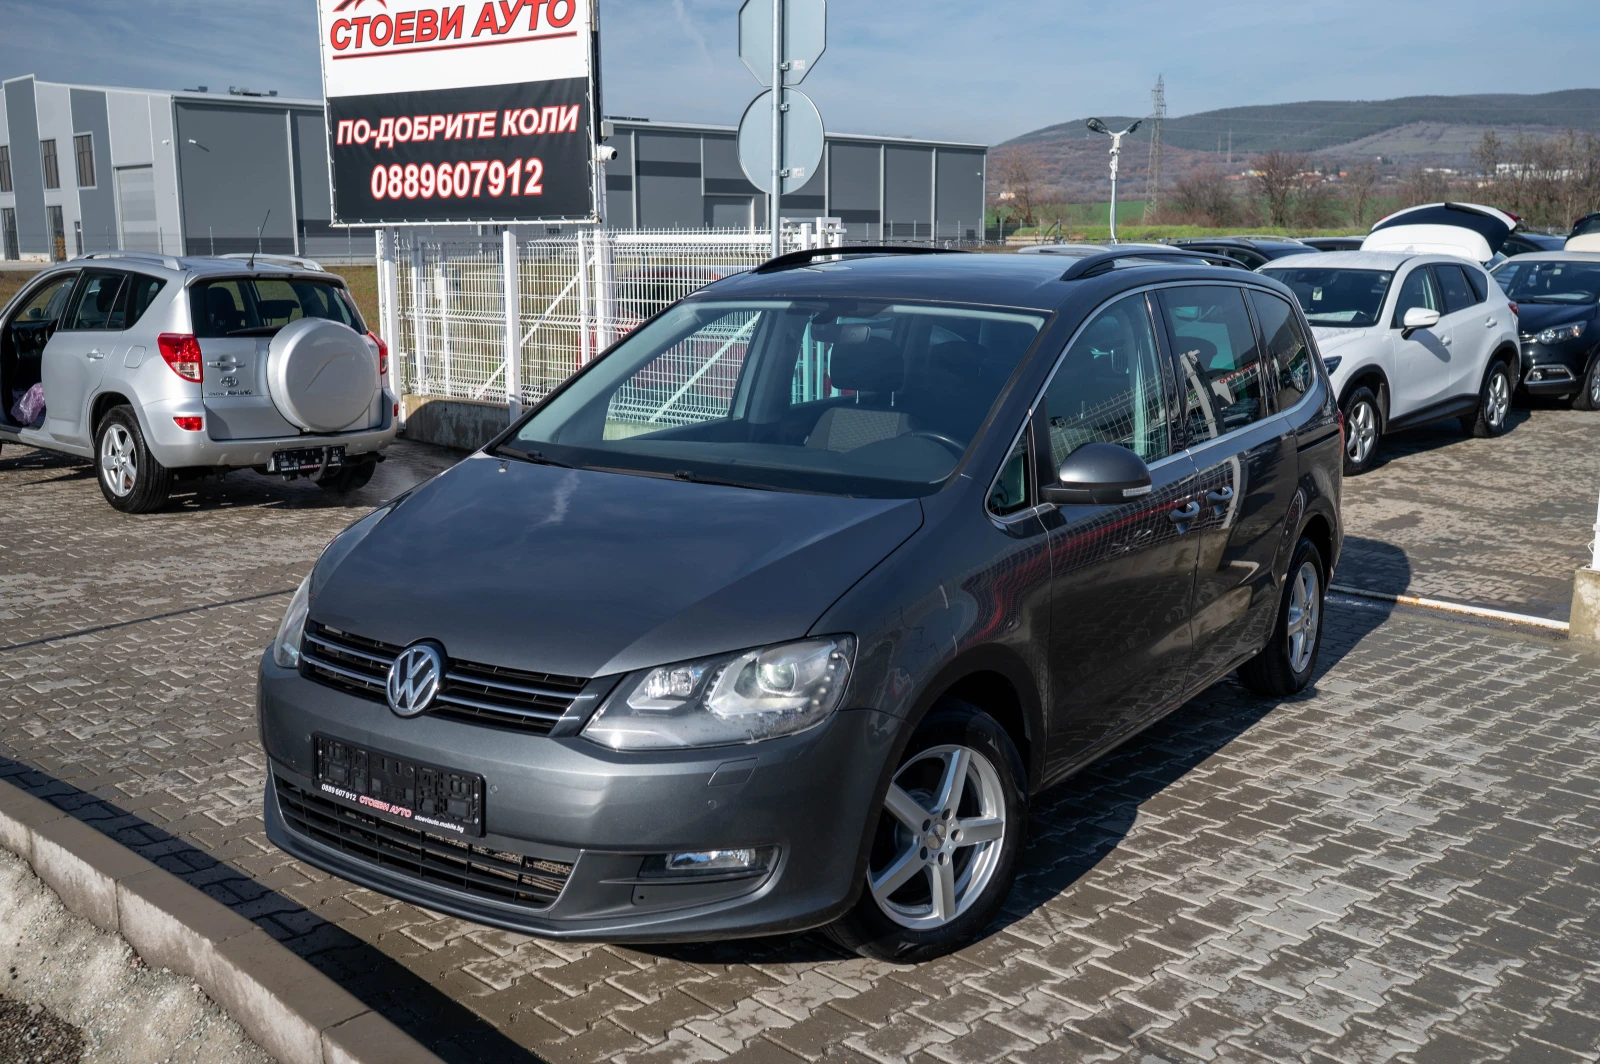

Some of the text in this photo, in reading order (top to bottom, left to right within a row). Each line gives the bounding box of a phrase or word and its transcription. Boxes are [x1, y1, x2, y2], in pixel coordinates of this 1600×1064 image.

[330, 0, 576, 51] СТОЕВИ АУТО
[336, 103, 580, 149] ПО-ДОБРИТЕ КОЛИ
[371, 157, 543, 200] 0889607912
[345, 791, 357, 801] 912
[390, 805, 412, 818] АУТО
